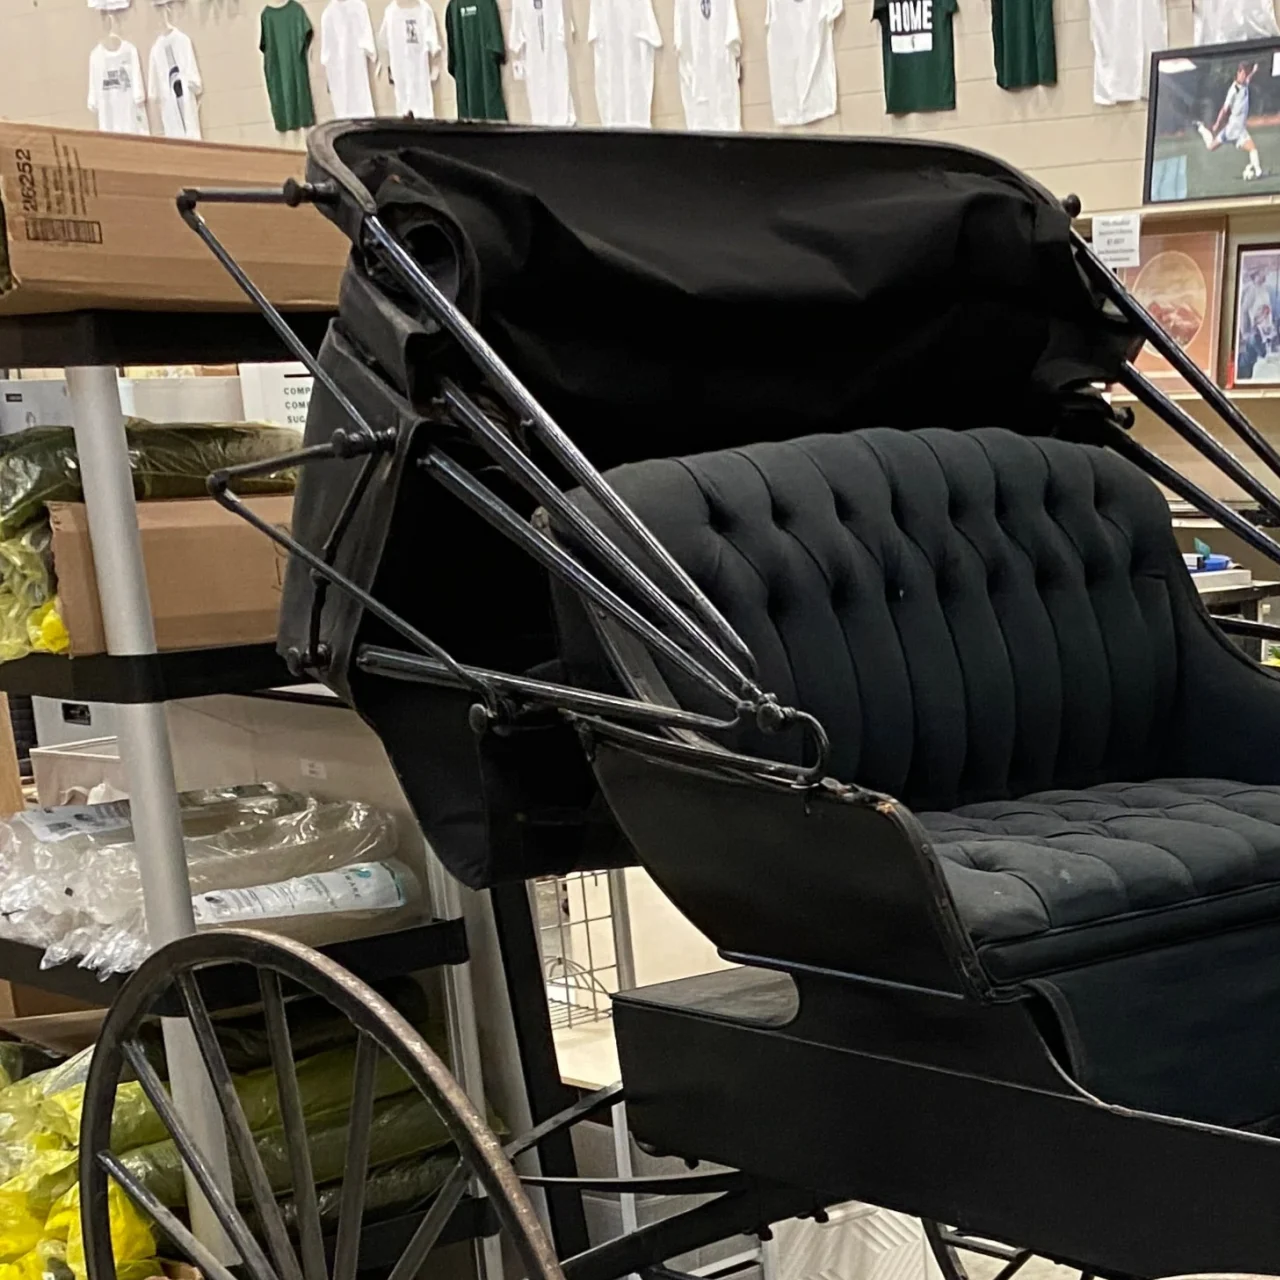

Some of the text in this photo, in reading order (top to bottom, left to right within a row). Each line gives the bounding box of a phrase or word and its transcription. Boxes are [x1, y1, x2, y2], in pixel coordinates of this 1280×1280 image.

[888, 0, 933, 32] HOME
[15, 148, 38, 212] 26252
[285, 401, 310, 409] COM
